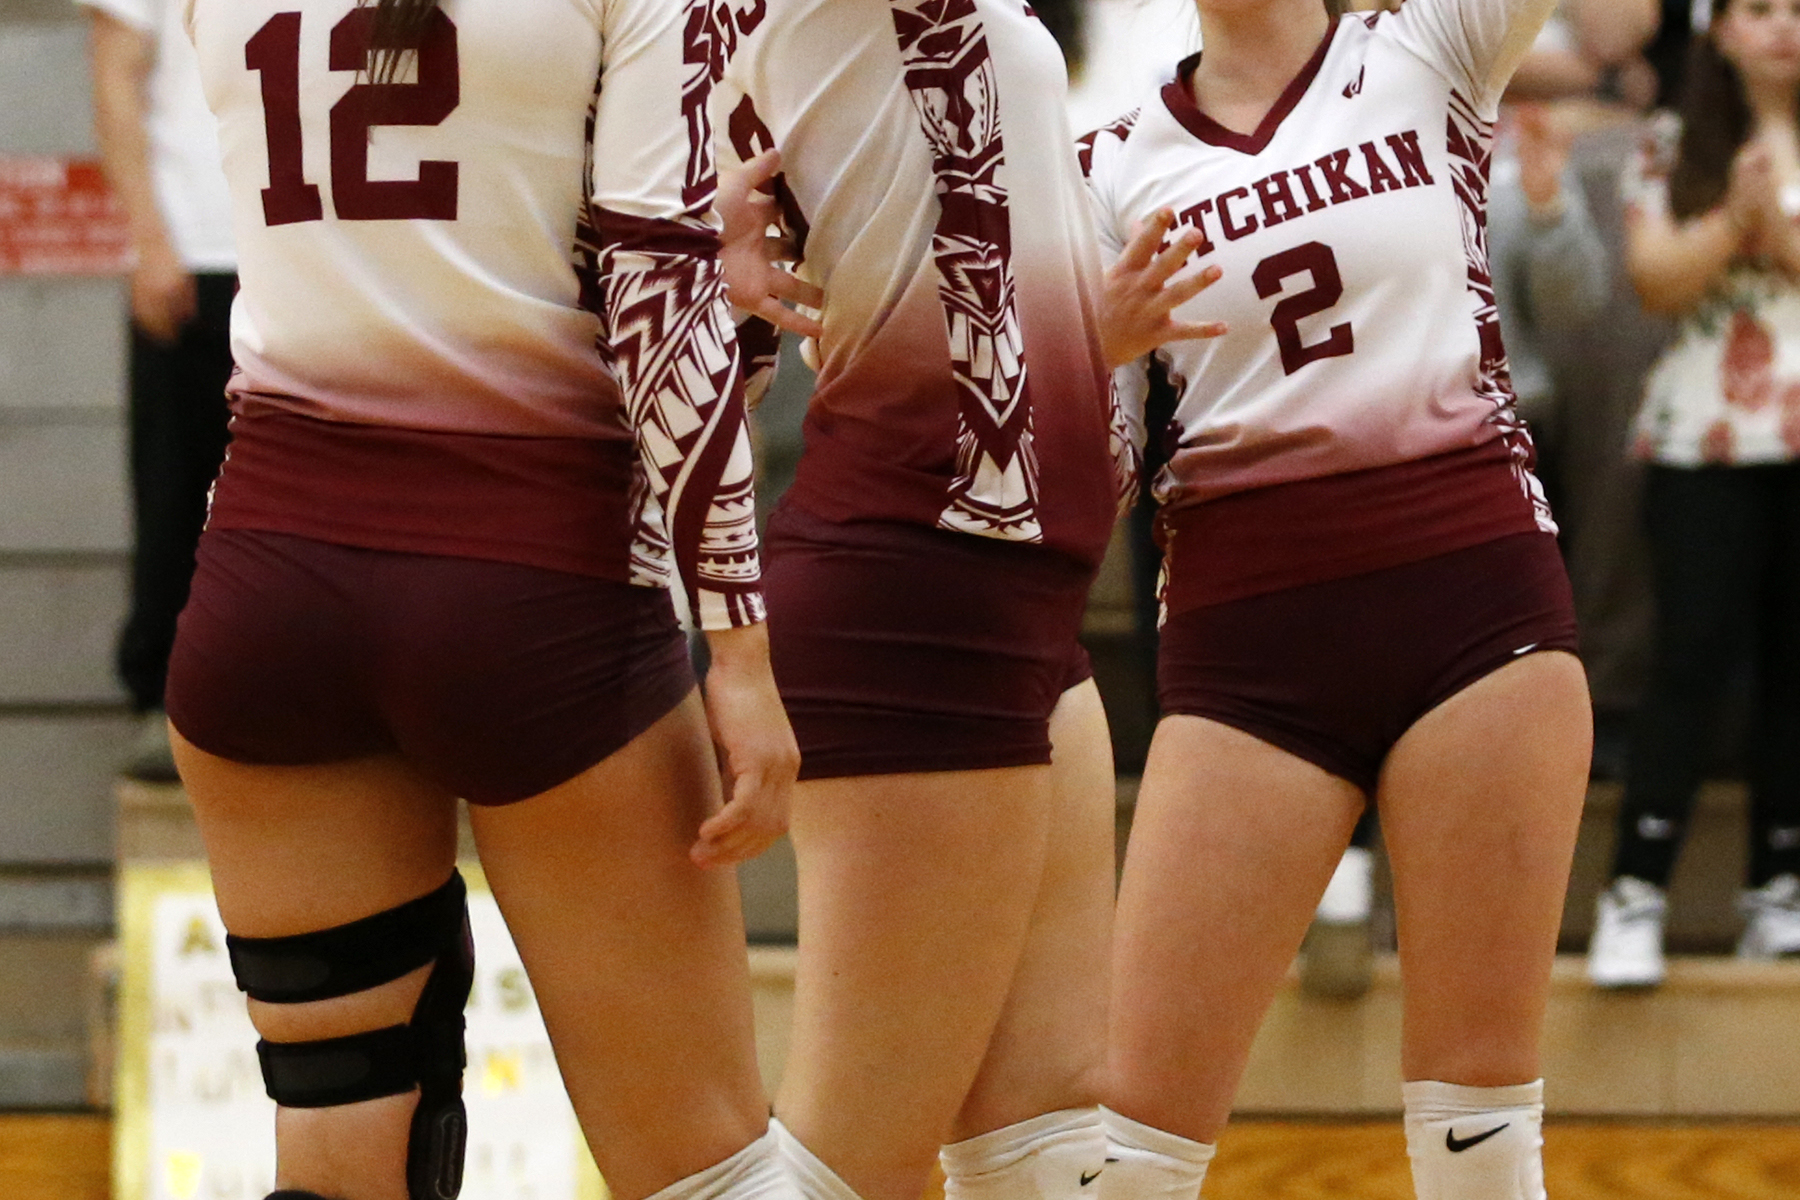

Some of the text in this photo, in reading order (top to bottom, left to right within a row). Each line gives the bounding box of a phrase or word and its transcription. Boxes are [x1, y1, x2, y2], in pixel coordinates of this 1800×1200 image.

[245, 3, 460, 227] 12
[1157, 129, 1436, 266] TCHIKAN
[1251, 240, 1355, 377] 2
